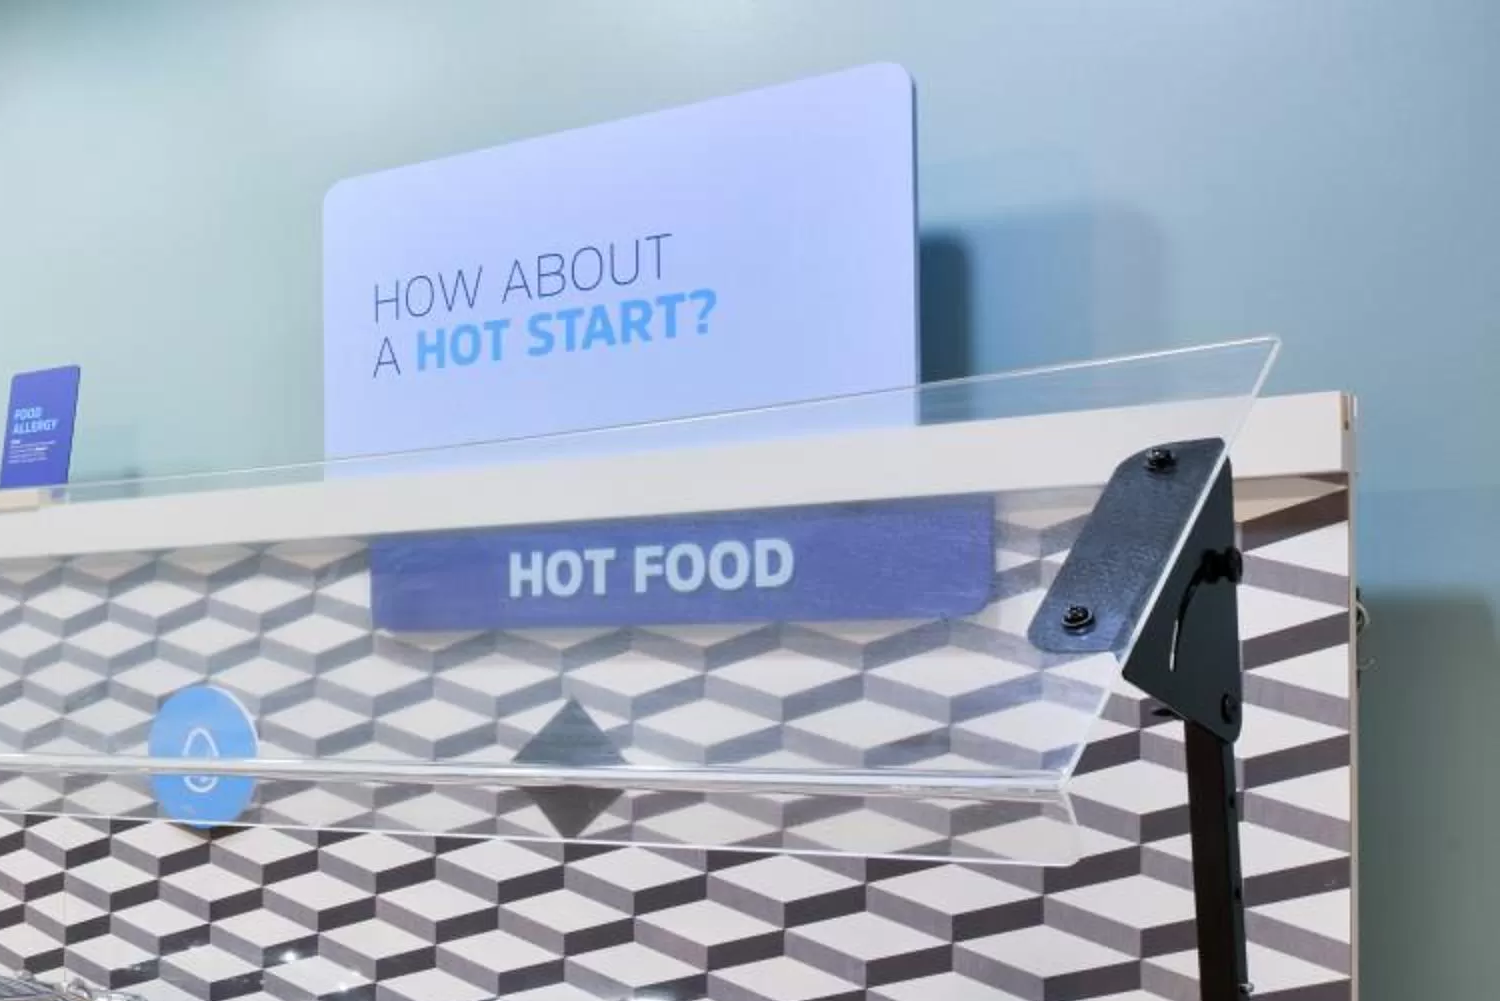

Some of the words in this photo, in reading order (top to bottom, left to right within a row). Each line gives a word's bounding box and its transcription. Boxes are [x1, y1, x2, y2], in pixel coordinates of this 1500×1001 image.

[373, 265, 483, 323] HOW
[502, 233, 673, 304] ABOUT
[373, 336, 401, 378] A
[416, 319, 510, 371] HOT
[526, 289, 718, 357] START?
[12, 419, 58, 434] ALLERGY
[14, 407, 43, 420] FOOD
[508, 547, 616, 597] HOT
[634, 538, 795, 594] FOOD
